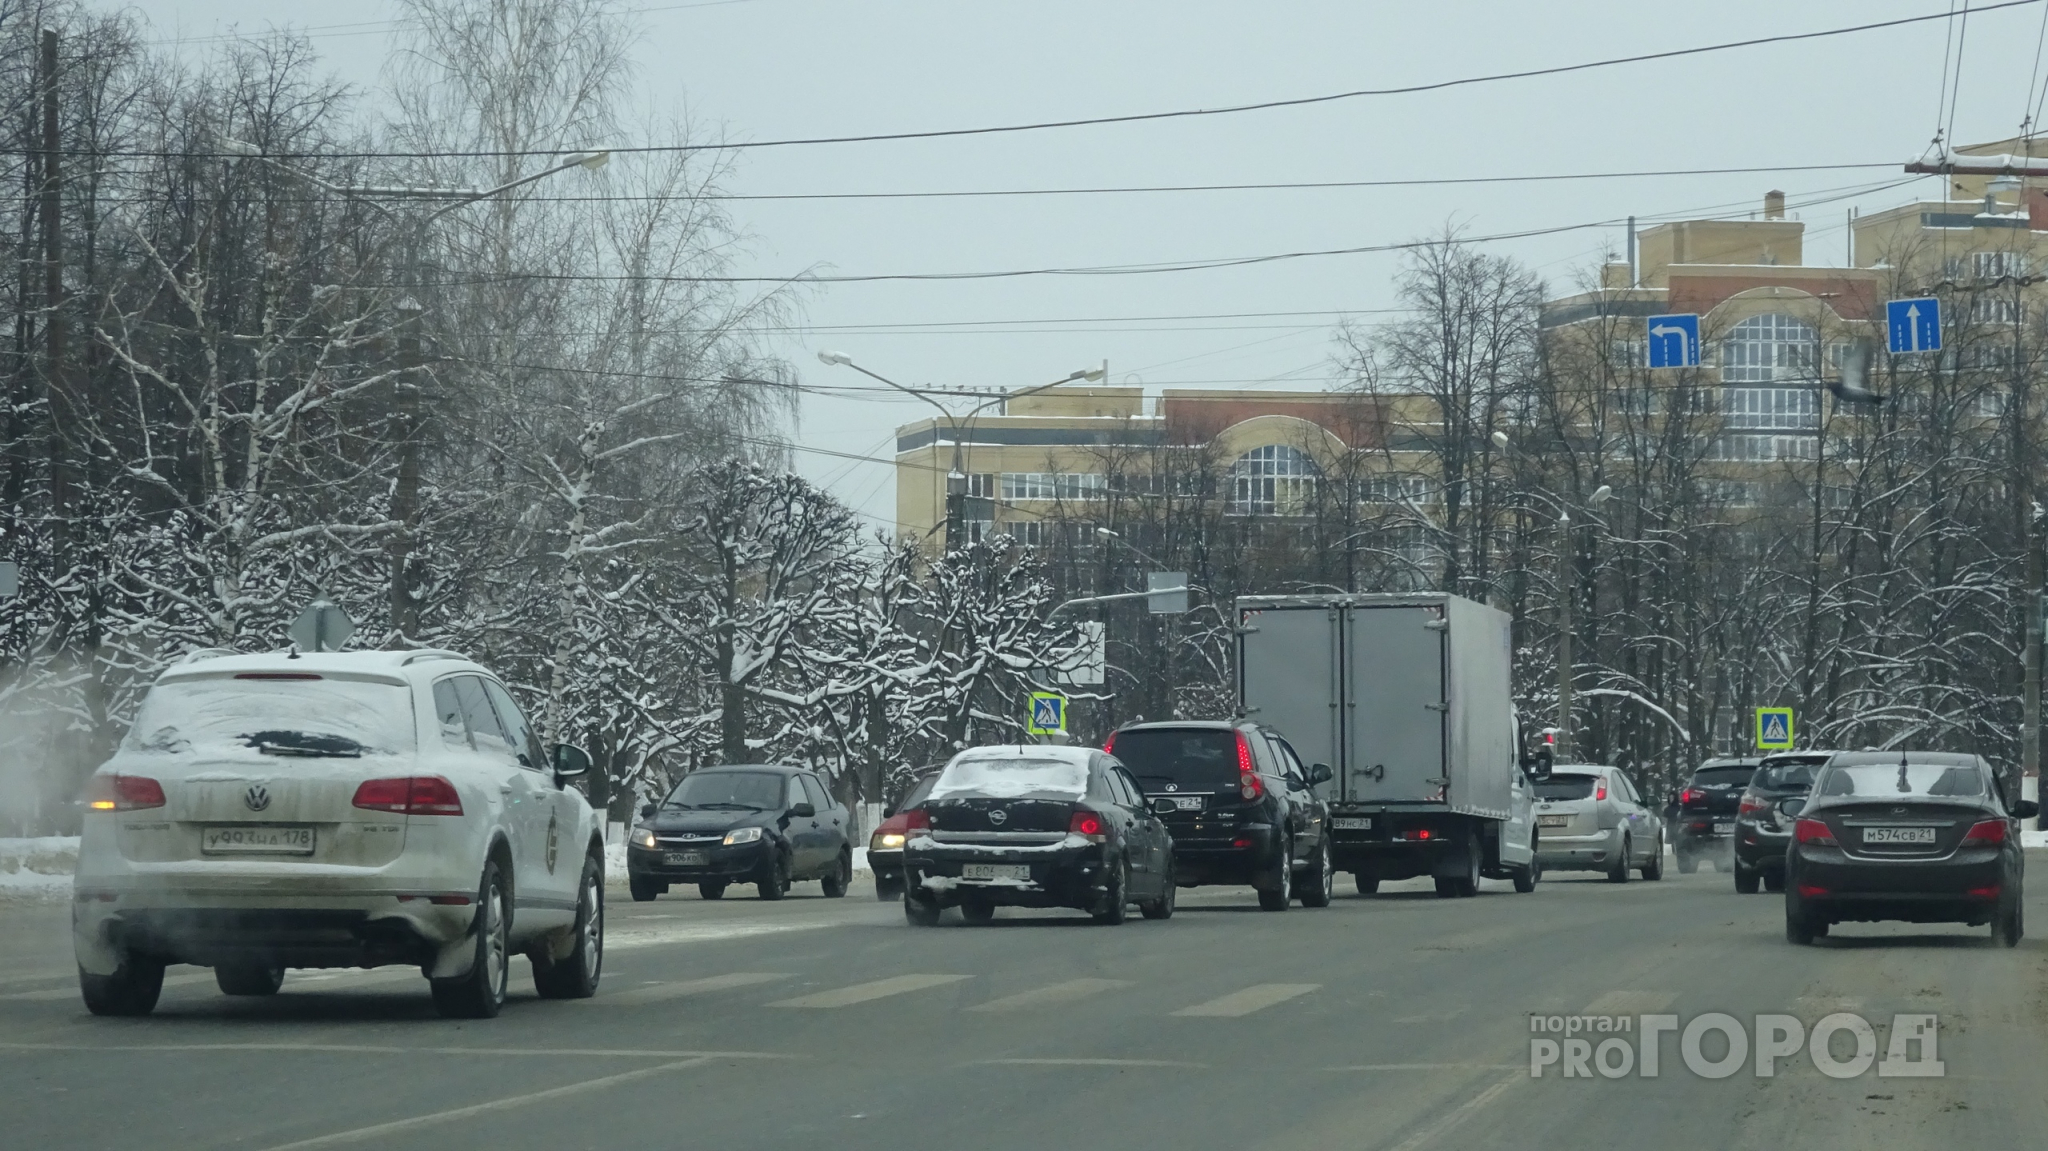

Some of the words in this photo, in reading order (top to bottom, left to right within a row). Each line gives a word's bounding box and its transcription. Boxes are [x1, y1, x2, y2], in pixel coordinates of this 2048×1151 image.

[283, 830, 310, 845] 178
[1867, 829, 1916, 841] М574СВ
[1919, 829, 1932, 838] 21
